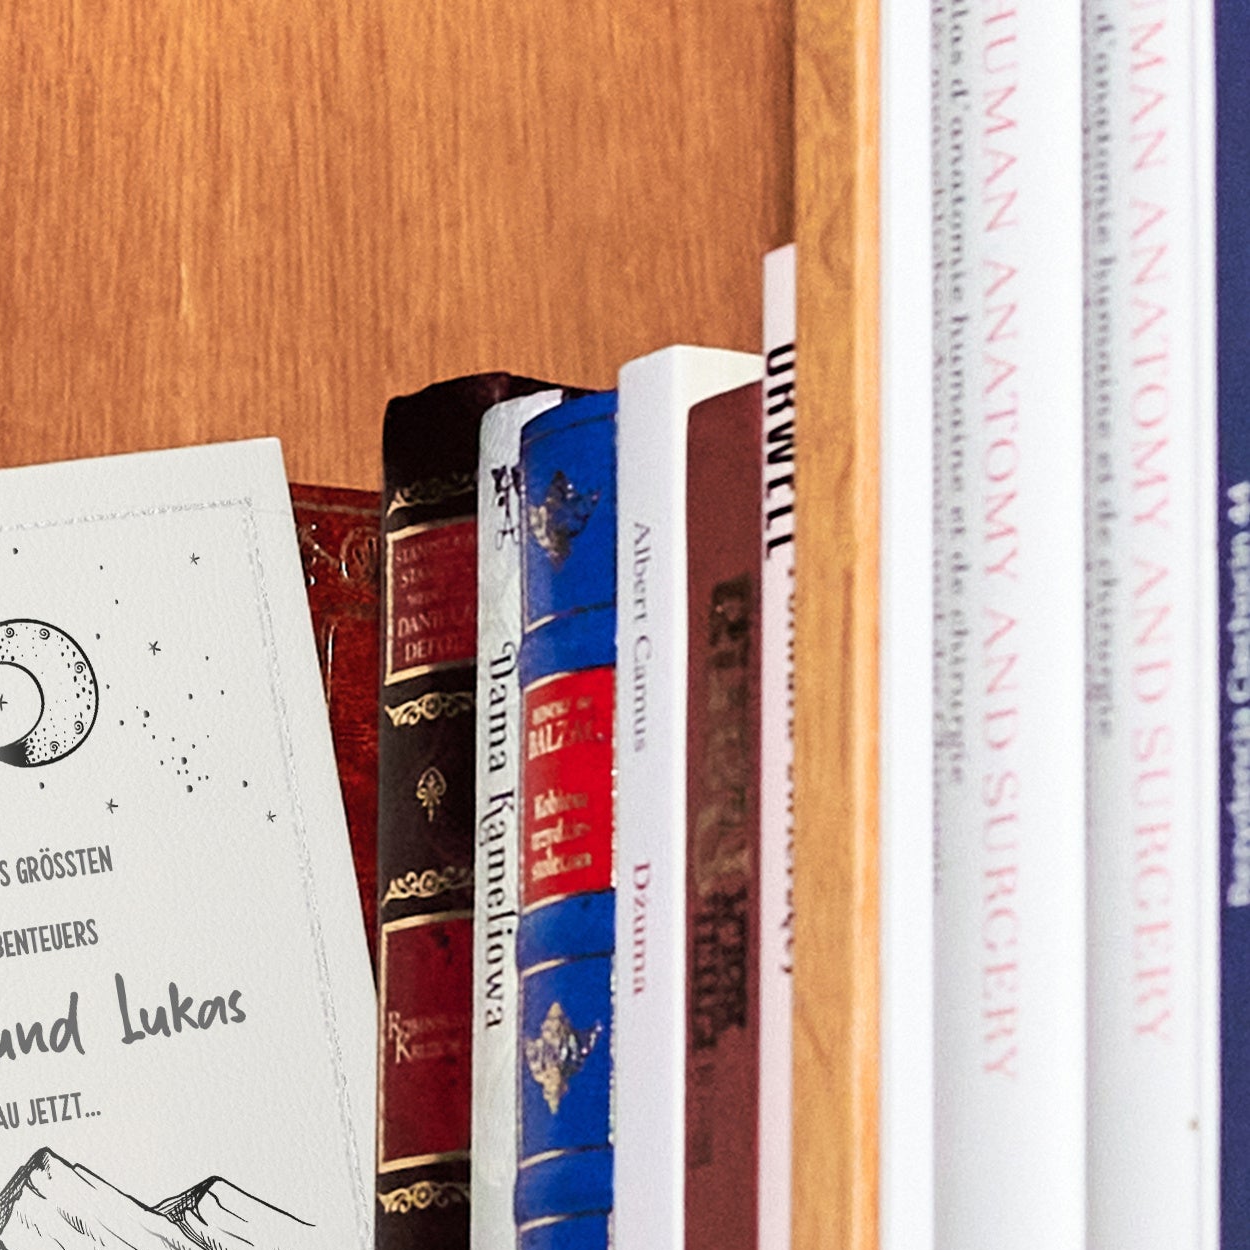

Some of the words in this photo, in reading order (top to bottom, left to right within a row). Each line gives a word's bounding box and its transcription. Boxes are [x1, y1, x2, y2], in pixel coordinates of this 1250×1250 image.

[1130, 0, 1167, 171] MAN
[983, 258, 1018, 583] ANATOMY
[1131, 198, 1170, 527] ANATOMY
[766, 343, 796, 560] ORWELL
[633, 521, 652, 624] Albert
[951, 551, 969, 596] de
[1133, 556, 1172, 705] AND
[487, 640, 518, 774] Dama
[633, 634, 652, 752] Camus
[983, 606, 1019, 752] AND
[15, 844, 113, 885] GRÖSSTEN
[478, 789, 518, 1030] Kameliowa
[983, 770, 1019, 1080] SURGERY
[1133, 723, 1174, 1043] SURGERY
[114, 972, 247, 1045] Lukas
[26, 1091, 102, 1127] JETZT...
